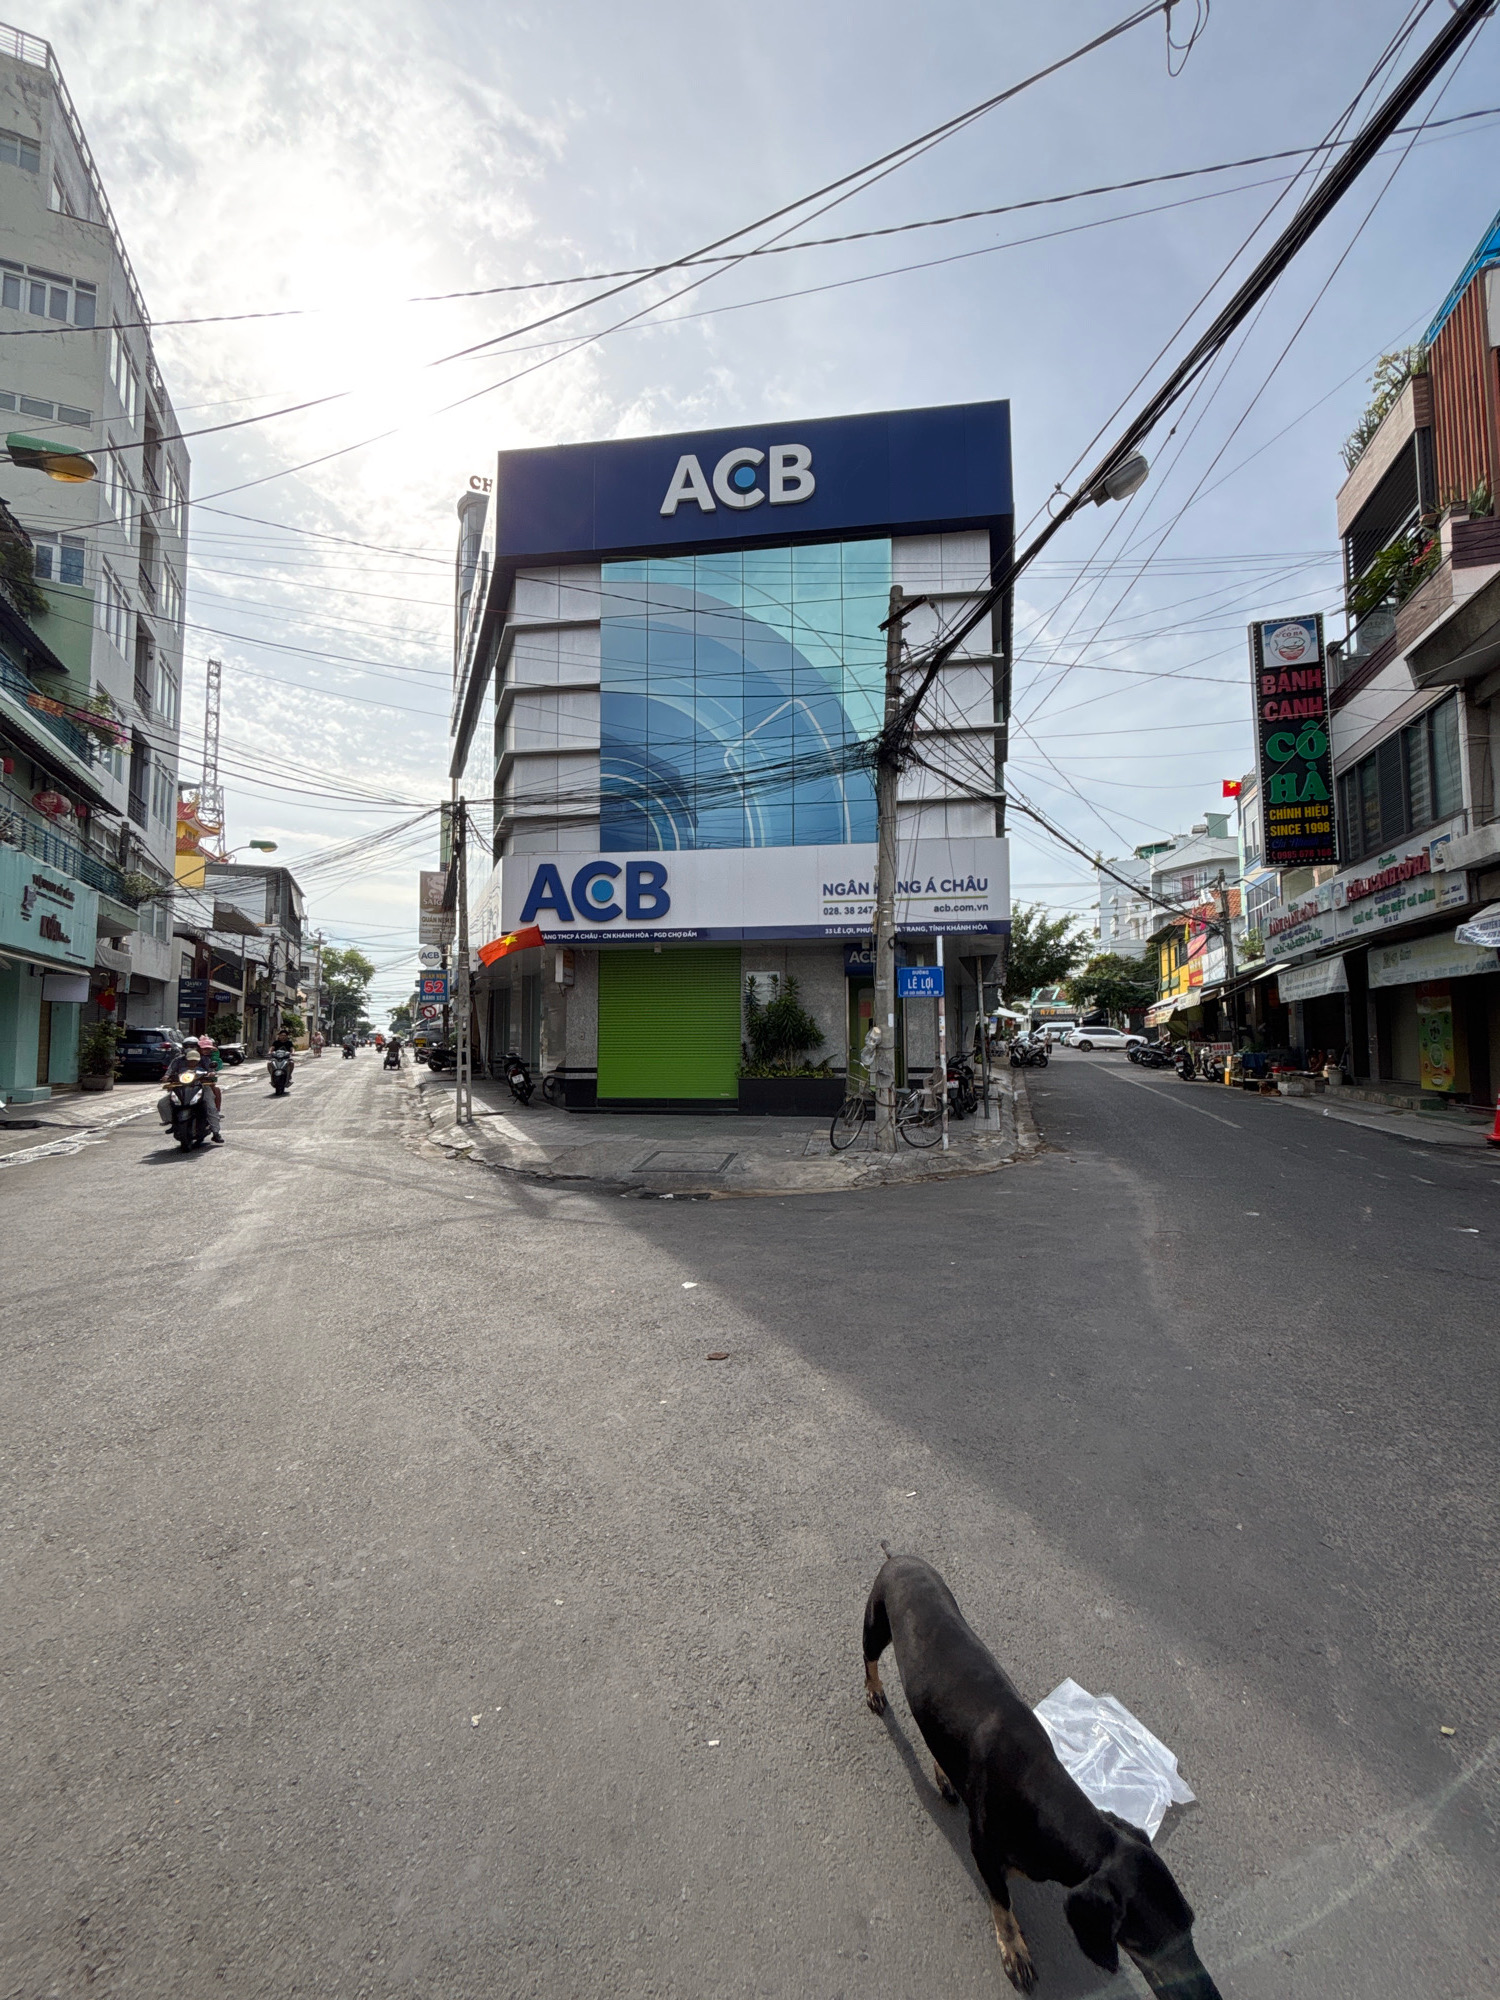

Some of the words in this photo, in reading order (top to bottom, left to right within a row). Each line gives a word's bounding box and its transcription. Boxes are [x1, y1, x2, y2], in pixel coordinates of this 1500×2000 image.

[660, 443, 815, 516] ACB
[1261, 666, 1322, 695] BÁNH
[1263, 696, 1323, 721] CANH
[1265, 719, 1328, 762] CÔ
[1268, 761, 1332, 804] HÀ
[1269, 805, 1302, 820] CHÍNH
[1304, 804, 1329, 819] HIỆU
[1270, 823, 1302, 836] SINCE
[1304, 821, 1330, 834] 1998
[519, 860, 671, 922] ACB
[823, 879, 869, 896] NGÂN
[925, 877, 937, 893] Á
[940, 875, 988, 893] CHÂU
[823, 907, 842, 915] 028.
[844, 907, 855, 915] 38
[857, 906, 873, 915] 247
[933, 903, 988, 913] acb.com.vn
[946, 923, 971, 932] KHÁNH
[972, 922, 988, 931] HÒA
[542, 932, 557, 940] ÀNG
[580, 931, 598, 940] CHÂU
[612, 931, 635, 939] KHÁNH
[421, 951, 440, 960] ACB
[423, 980, 444, 994] 52
[907, 976, 918, 989] LÊ
[921, 976, 934, 990] LỢI
